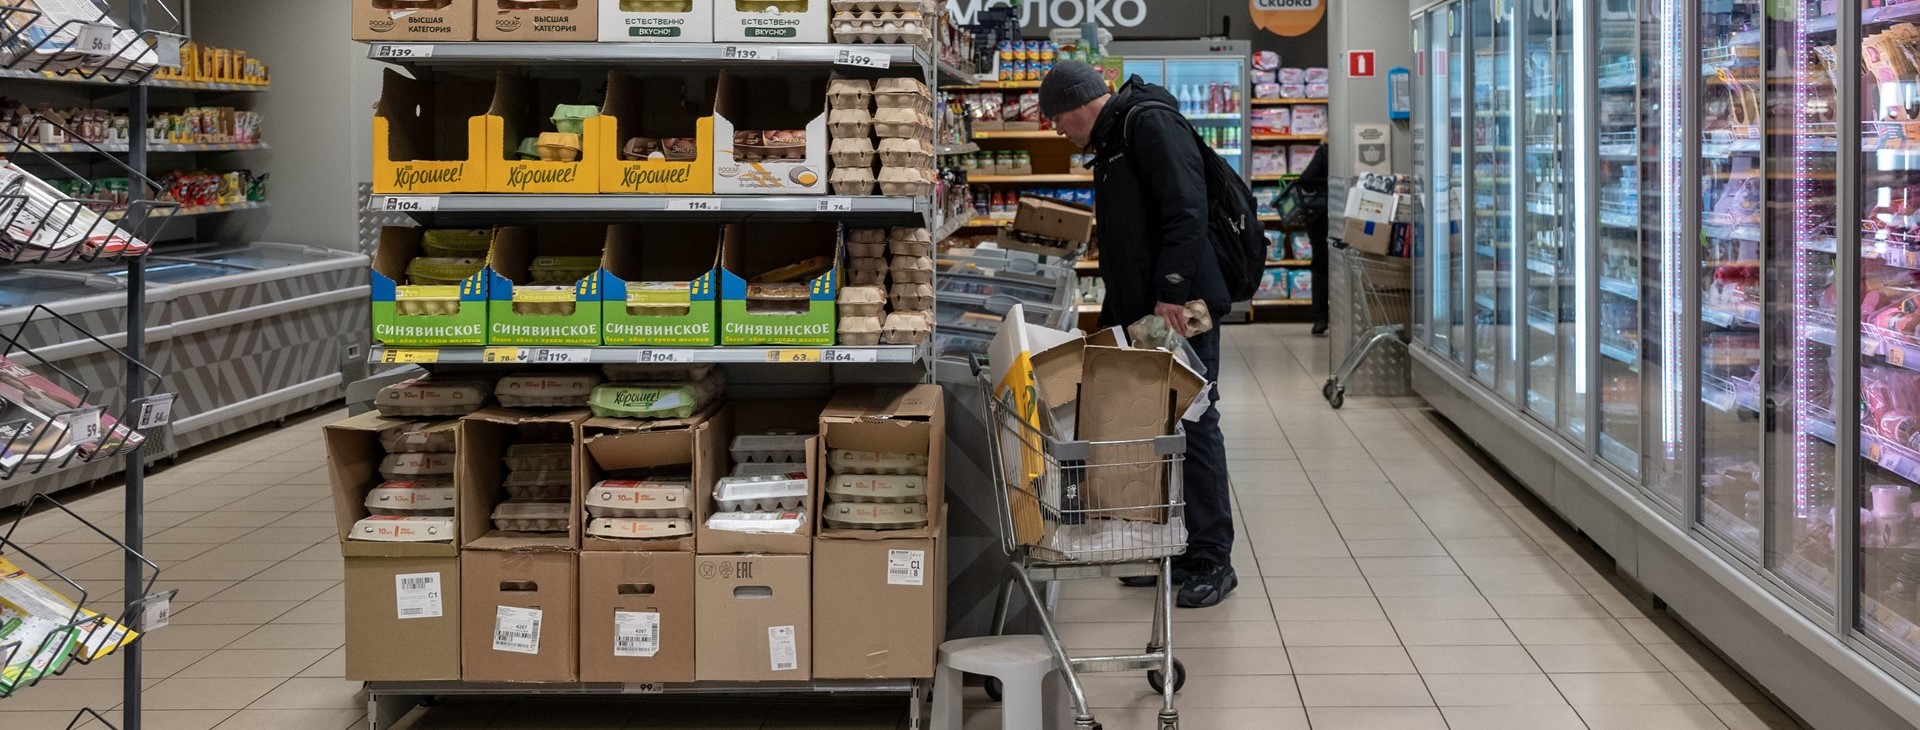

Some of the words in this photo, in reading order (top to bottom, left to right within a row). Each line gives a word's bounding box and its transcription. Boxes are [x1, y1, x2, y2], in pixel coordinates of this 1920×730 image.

[408, 16, 444, 24] ВЫСШАЯ
[534, 15, 569, 23] ВЫСШАЯ
[741, 18, 800, 26] ЕСТЕСТВЕННО
[638, 28, 671, 36] ВКУСНО!
[754, 28, 787, 36] ВКУСНО!
[92, 37, 103, 50] 56
[390, 48, 412, 57] 139
[736, 50, 758, 58] 139
[849, 55, 871, 65] 199
[394, 163, 464, 191] Хорошее!
[506, 163, 578, 191] Хорошее!
[620, 163, 692, 191] Хорошее!
[397, 201, 419, 210] 104
[688, 201, 707, 210] 114
[376, 323, 482, 337] СИНЯВИНСКОЕ
[492, 322, 597, 337] СИНЯВИНСКОЕ
[605, 322, 710, 336] СИНЯВИНСКОЕ
[725, 322, 830, 336] СИНЯВИНСКОЕ
[549, 353, 568, 361] 119
[652, 353, 674, 361] 104
[792, 353, 807, 362] 63
[835, 353, 851, 361] 64
[614, 389, 660, 407] Хорошее!
[87, 423, 97, 437] 59
[640, 683, 653, 692] 99
